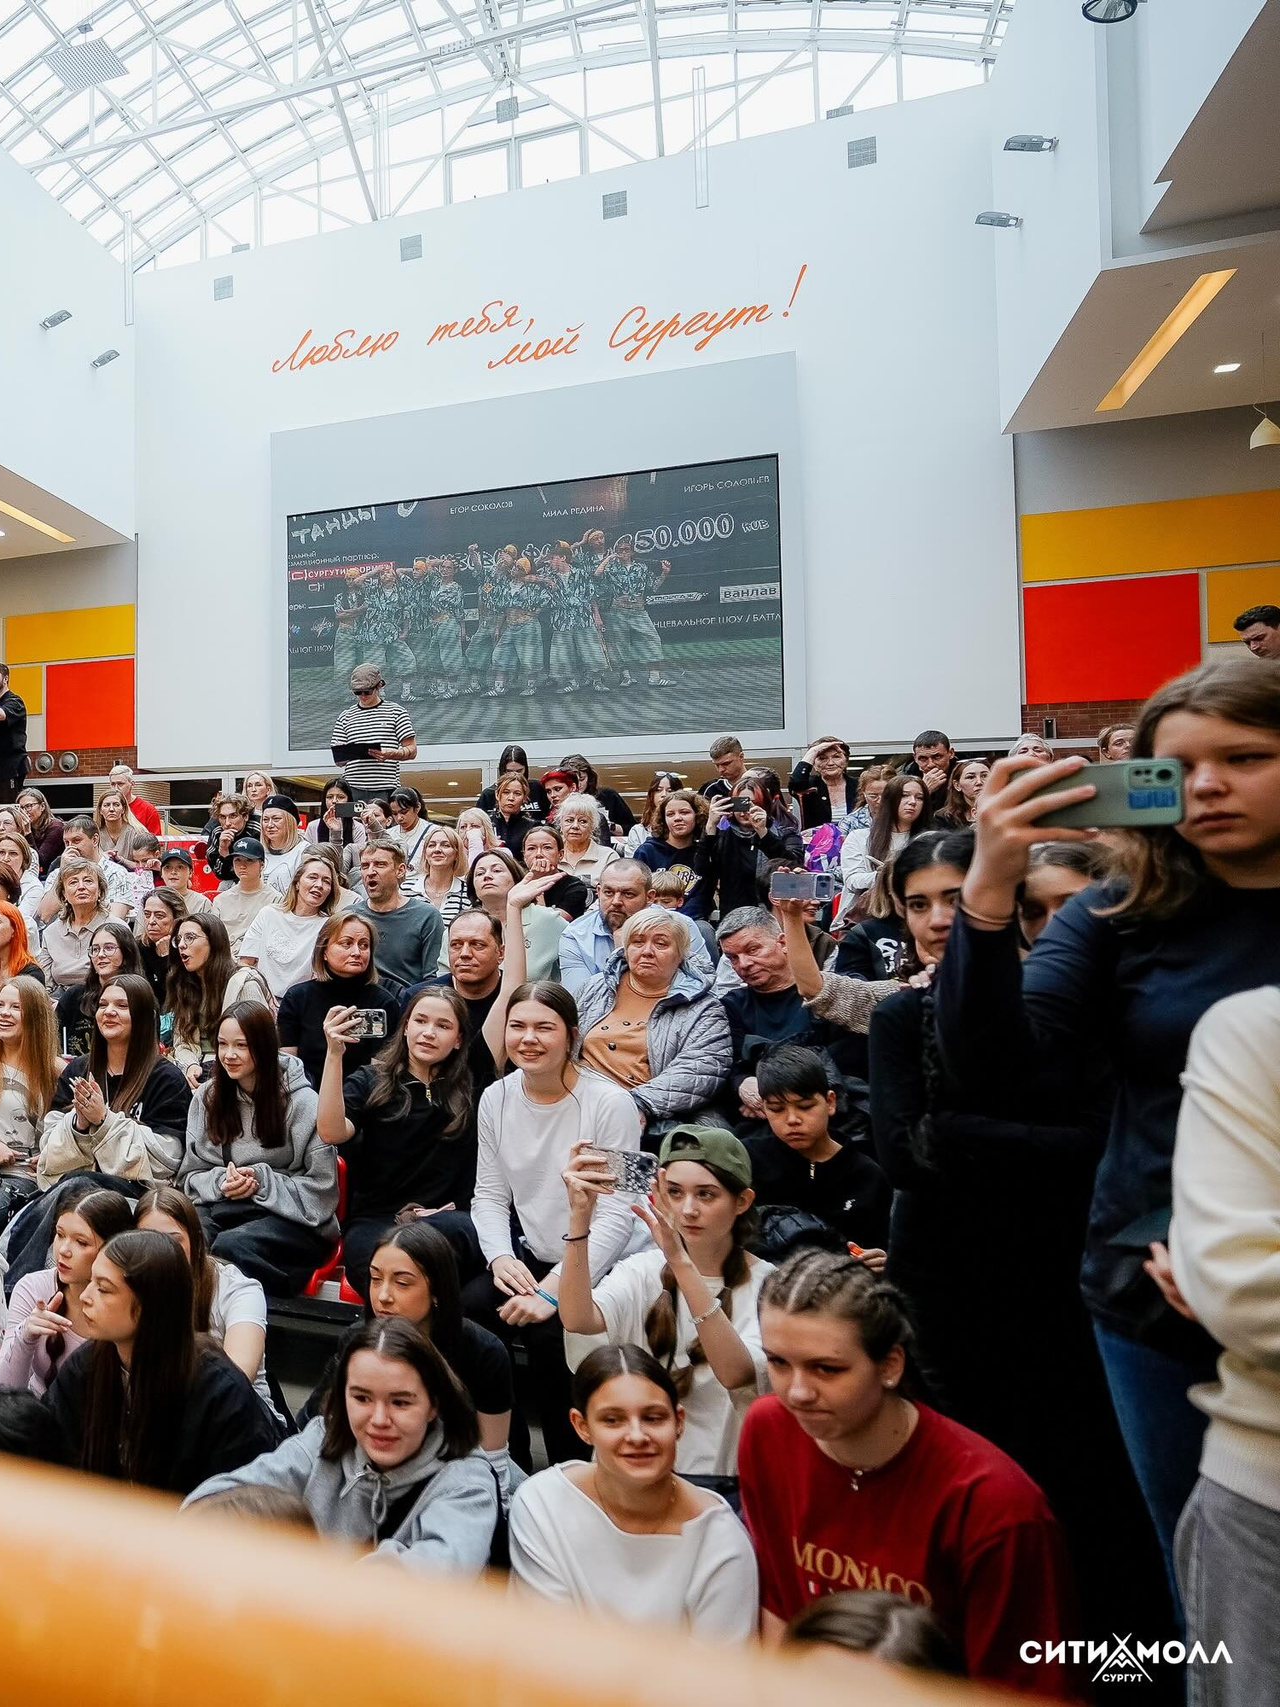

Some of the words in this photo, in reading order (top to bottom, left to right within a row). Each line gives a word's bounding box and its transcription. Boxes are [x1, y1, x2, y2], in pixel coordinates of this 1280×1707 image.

[487, 321, 587, 371] мой
[608, 263, 808, 362] Сургут!
[272, 328, 400, 374] Люблю
[426, 299, 536, 346] тебя,
[683, 482, 715, 494] ИГОРЬ
[449, 505, 470, 516] ЕГОР
[471, 500, 514, 513] СОКОЛОВ
[542, 509, 569, 519] МИЛА
[570, 504, 605, 516] РЕДИНА
[291, 506, 377, 545] ТАНЦЫ
[723, 586, 778, 600] ванлав
